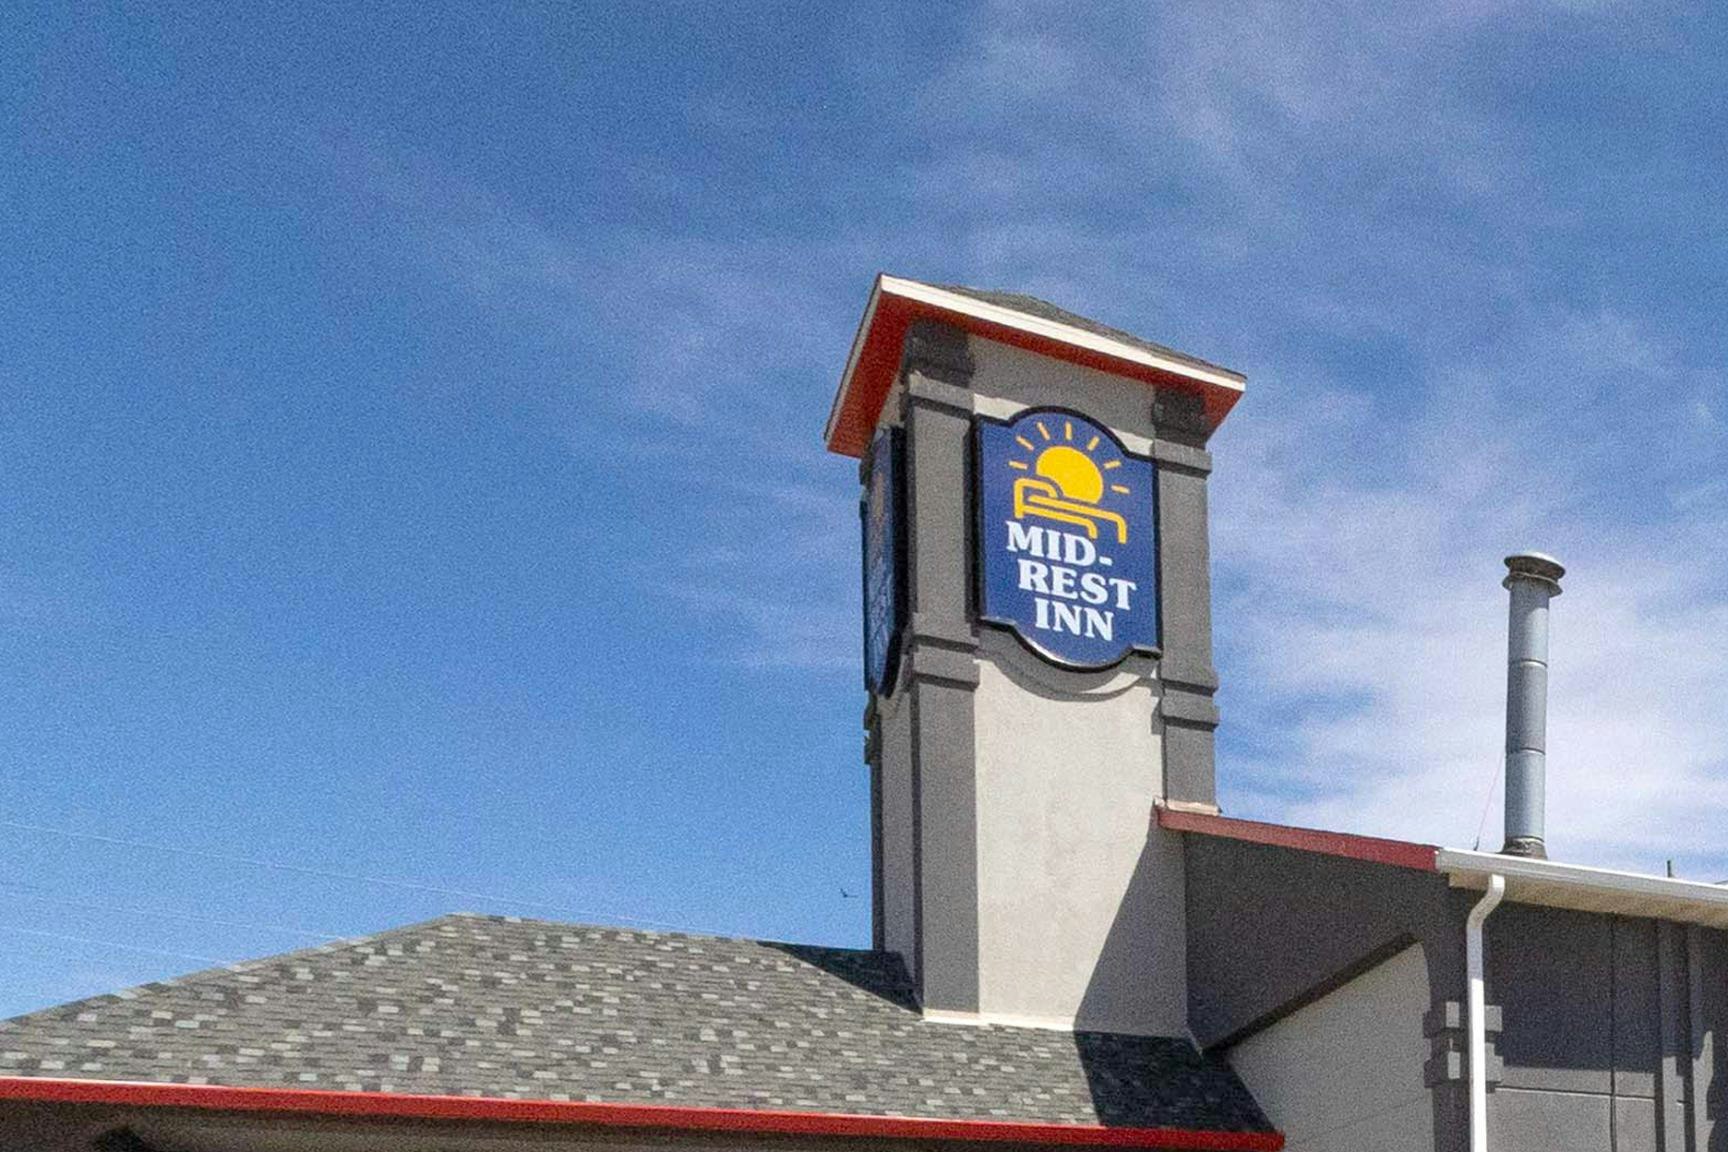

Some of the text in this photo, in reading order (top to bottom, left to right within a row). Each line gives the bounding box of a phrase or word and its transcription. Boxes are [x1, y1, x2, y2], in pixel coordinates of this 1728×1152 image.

[1006, 520, 1113, 566] MID-
[1017, 559, 1136, 611] REST
[1034, 598, 1115, 641] INN
